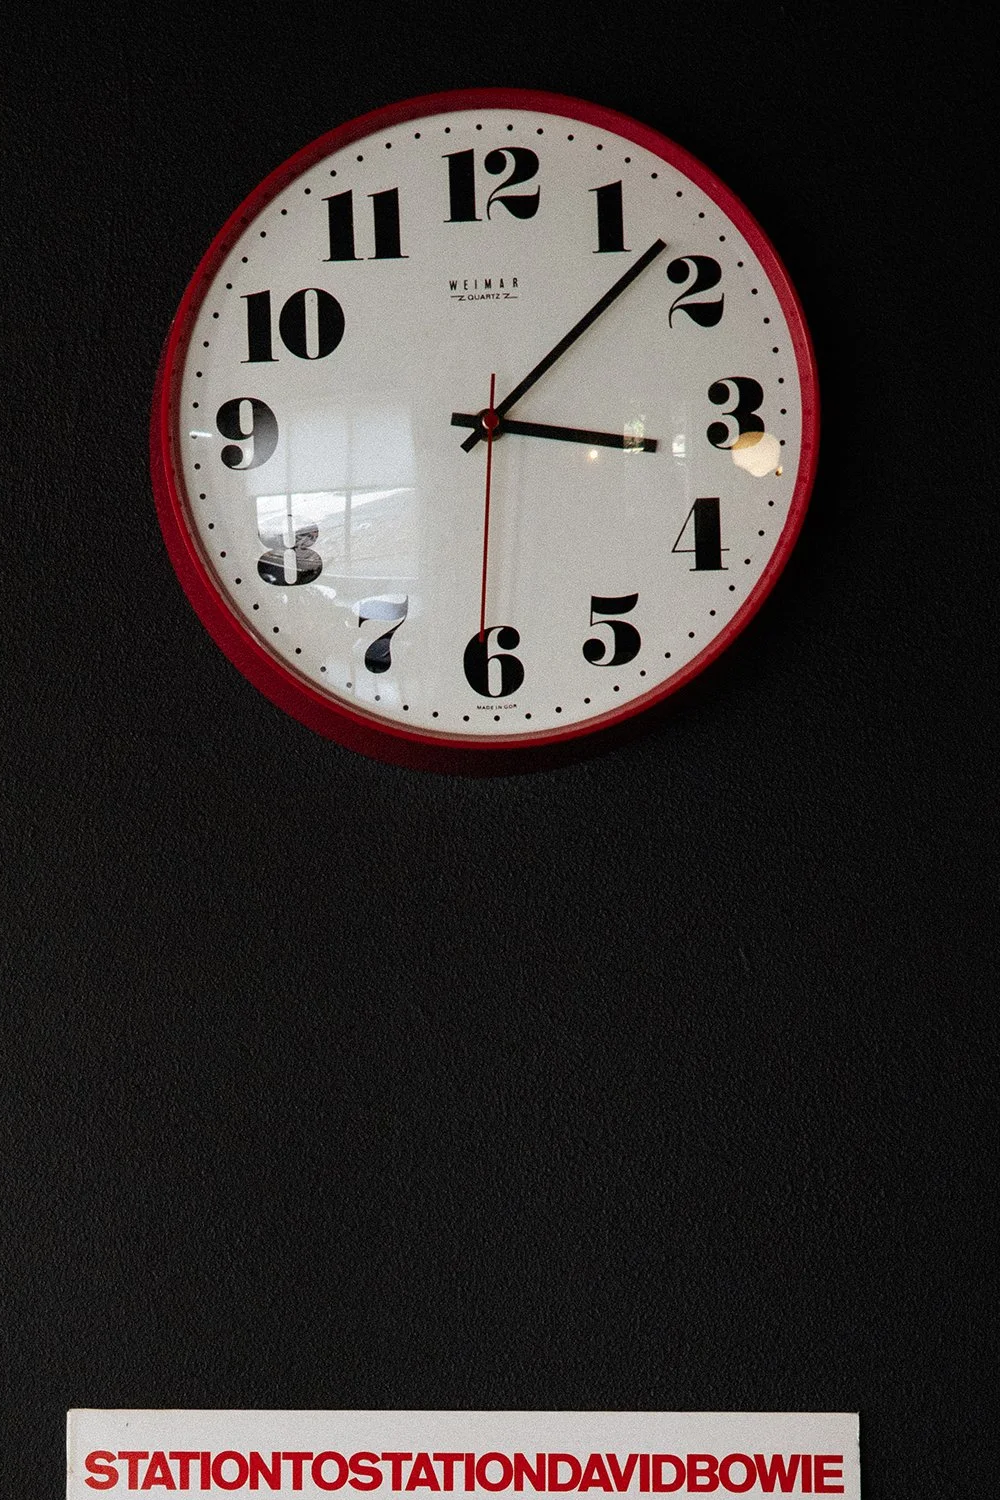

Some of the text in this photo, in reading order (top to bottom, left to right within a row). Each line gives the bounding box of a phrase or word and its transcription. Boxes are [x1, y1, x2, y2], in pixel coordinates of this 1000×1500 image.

[441, 146, 541, 223] 12
[588, 179, 632, 254] 1
[321, 186, 410, 262] 11
[448, 277, 519, 291] WEIMAR
[467, 293, 501, 301] QUARTZ
[665, 254, 725, 329] 2
[239, 287, 346, 363] 10
[215, 397, 279, 470] 9
[705, 376, 766, 450] 3
[256, 512, 323, 587] 8
[671, 497, 730, 572] 4
[352, 594, 409, 674] 7
[462, 625, 525, 698] 6
[582, 593, 642, 667] 5
